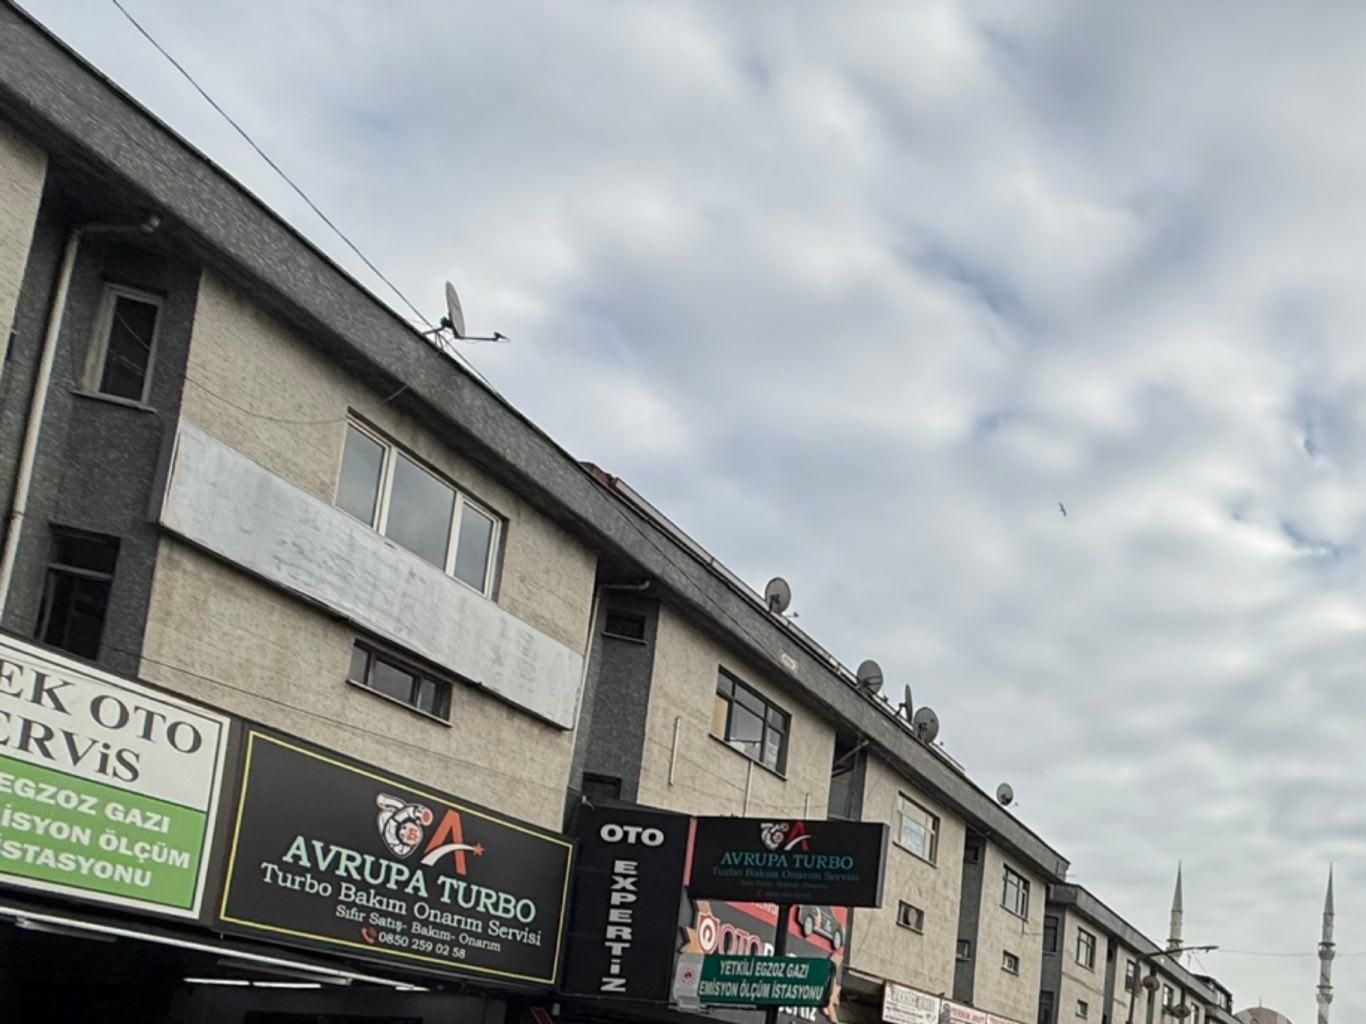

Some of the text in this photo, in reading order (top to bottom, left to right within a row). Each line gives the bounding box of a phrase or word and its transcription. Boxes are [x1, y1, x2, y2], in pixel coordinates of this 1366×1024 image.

[90, 695, 202, 754] OTO
[0, 772, 170, 834] EGZOZ GAZI
[99, 829, 191, 869] ÖLÇÜM
[600, 824, 665, 846] OTO
[720, 851, 854, 870] AVRUPA TURBO
[282, 835, 536, 923] AVRUPA TURBO
[261, 862, 542, 946] Turbo Bakım Onarım Servisi
[378, 931, 467, 959] 0850 259 02 58
[459, 933, 501, 952] Onarım
[720, 958, 755, 976] YETKİLİ
[755, 962, 786, 977] EGZOZ
[699, 978, 824, 1001] EMİSYON ÖLÇÜM İSTASYONU
